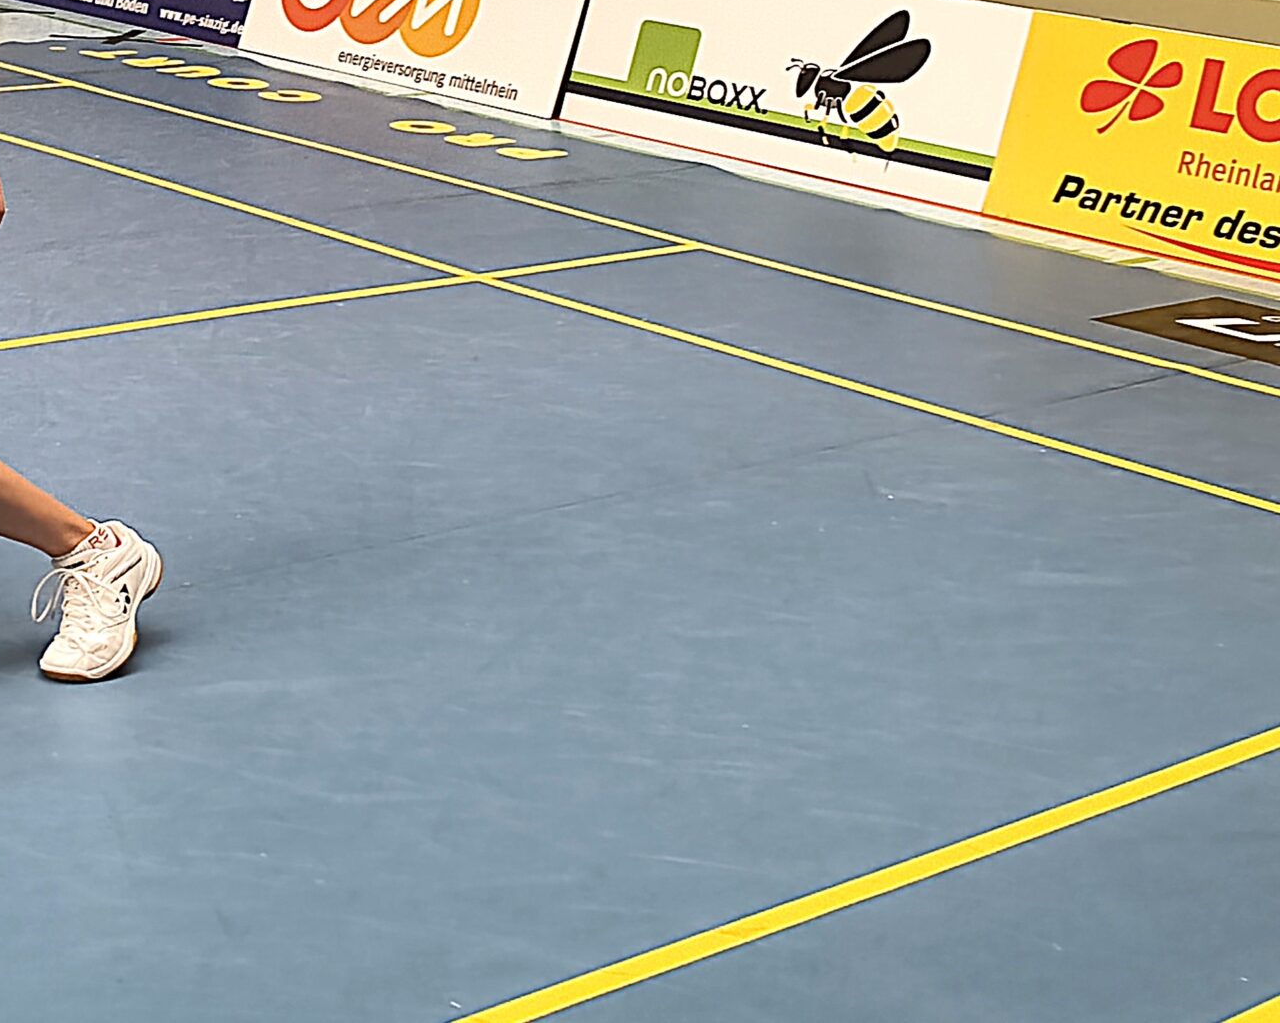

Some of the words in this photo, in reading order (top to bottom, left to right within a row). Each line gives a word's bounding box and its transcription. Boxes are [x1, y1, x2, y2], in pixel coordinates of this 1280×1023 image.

[337, 50, 446, 88] energieversorgung
[448, 73, 519, 101] mittelrhein
[1052, 174, 1204, 231] Partner
